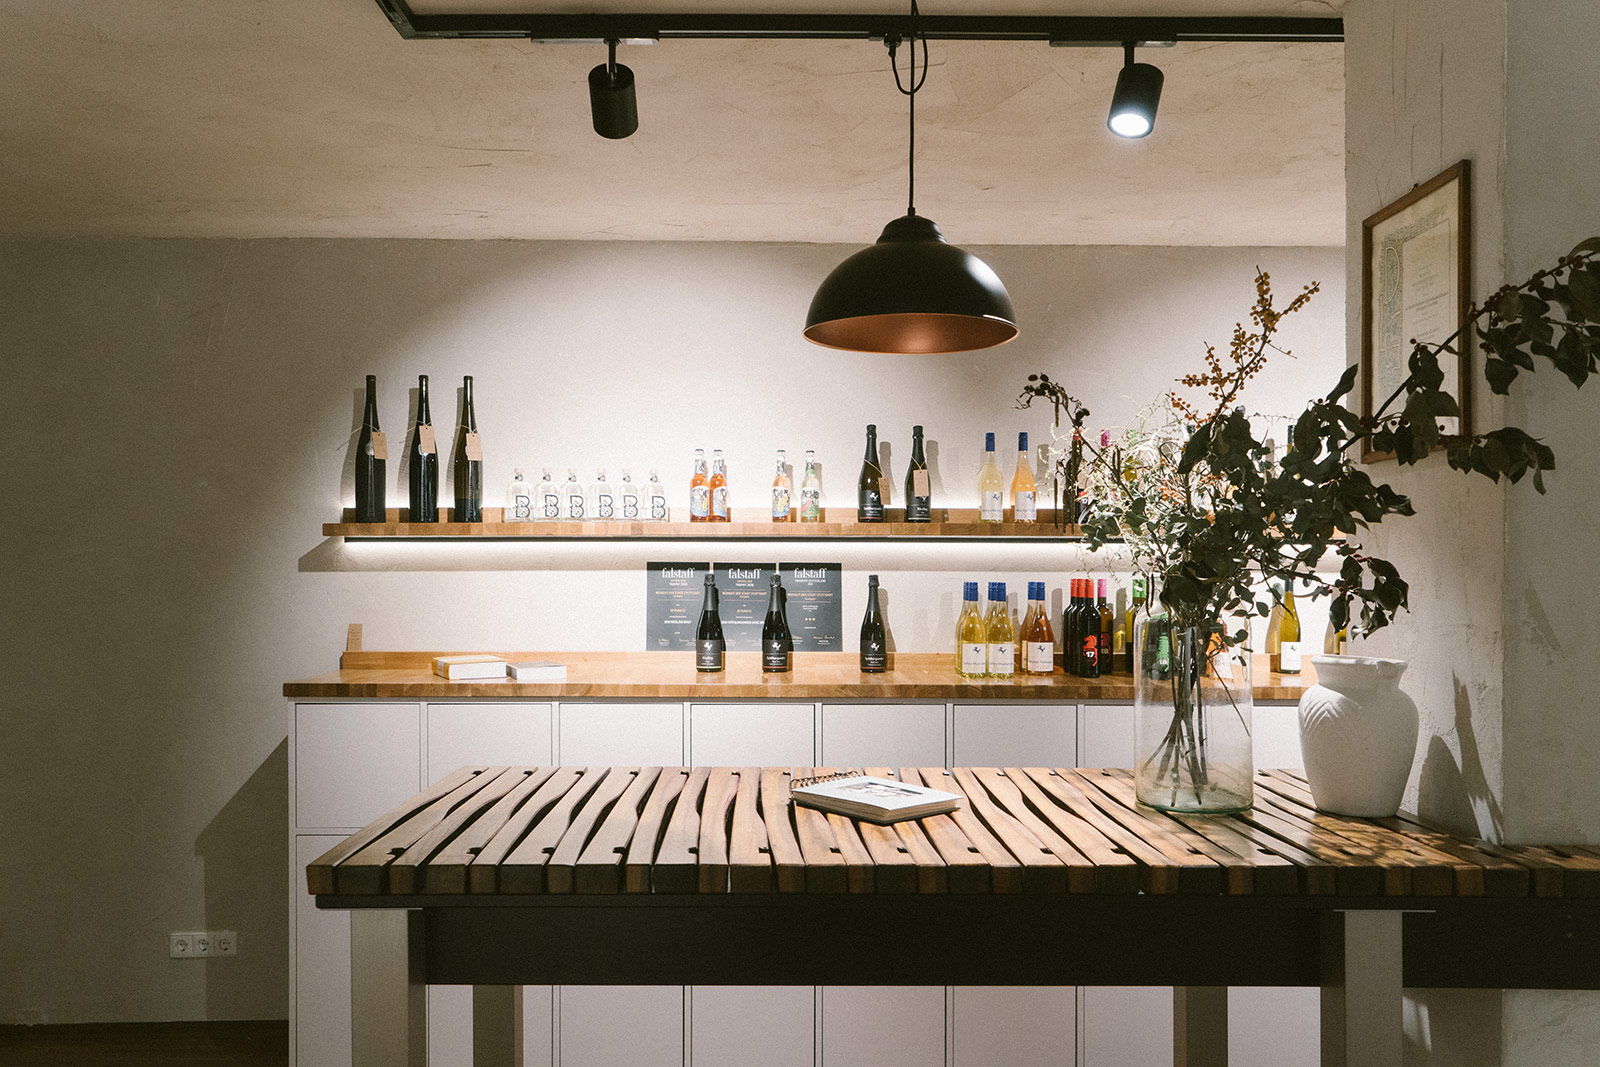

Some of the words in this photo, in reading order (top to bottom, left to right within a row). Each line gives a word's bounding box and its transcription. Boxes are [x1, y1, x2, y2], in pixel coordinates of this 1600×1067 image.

[662, 567, 696, 578] falstaff
[728, 568, 762, 579] falstaff
[794, 567, 827, 578] falstaff
